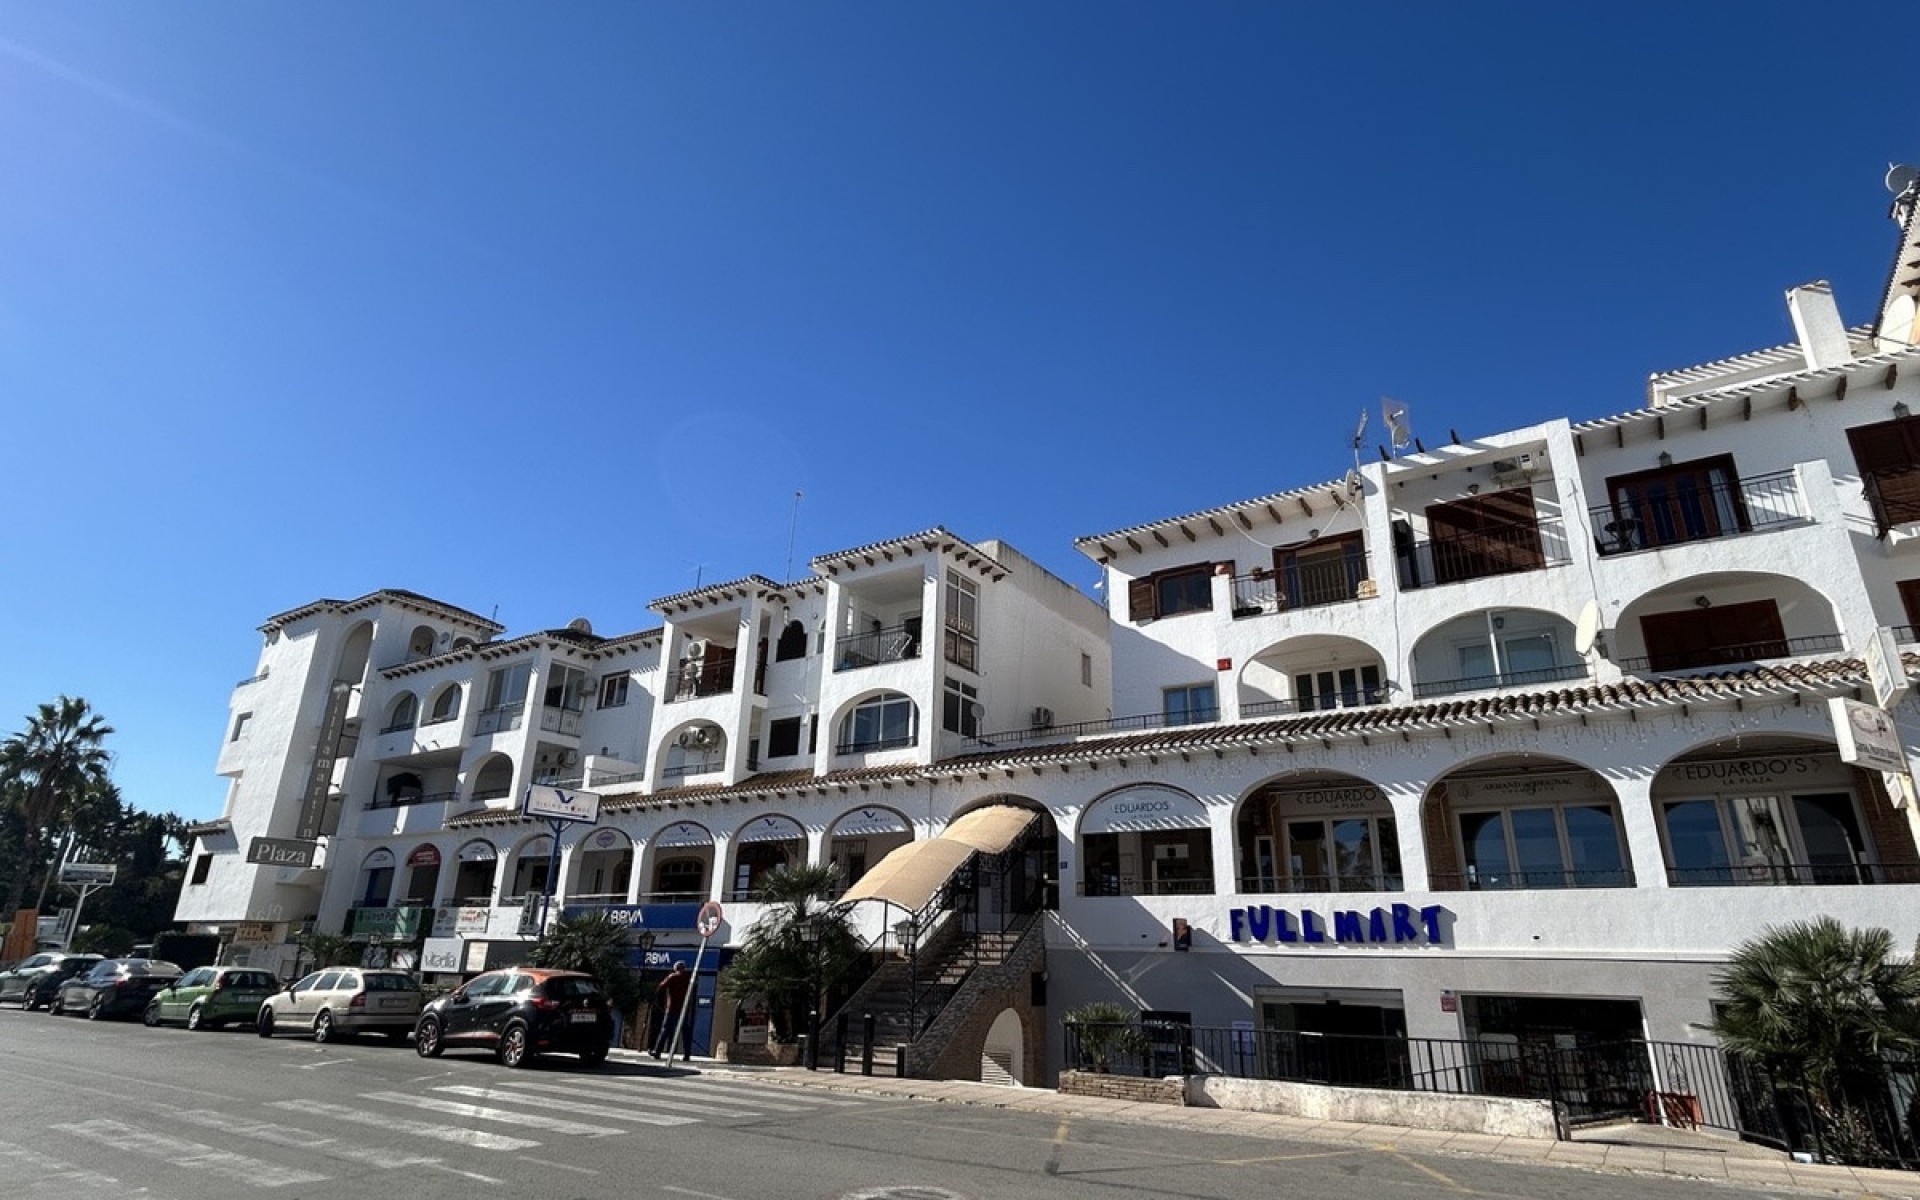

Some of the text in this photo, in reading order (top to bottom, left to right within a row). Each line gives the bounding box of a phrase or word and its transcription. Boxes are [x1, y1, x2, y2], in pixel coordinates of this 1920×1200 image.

[1686, 757, 1807, 780] EDUARDO'S
[256, 844, 307, 864] Plaza
[610, 908, 644, 924] BBVA
[1230, 903, 1441, 943] FULL MART
